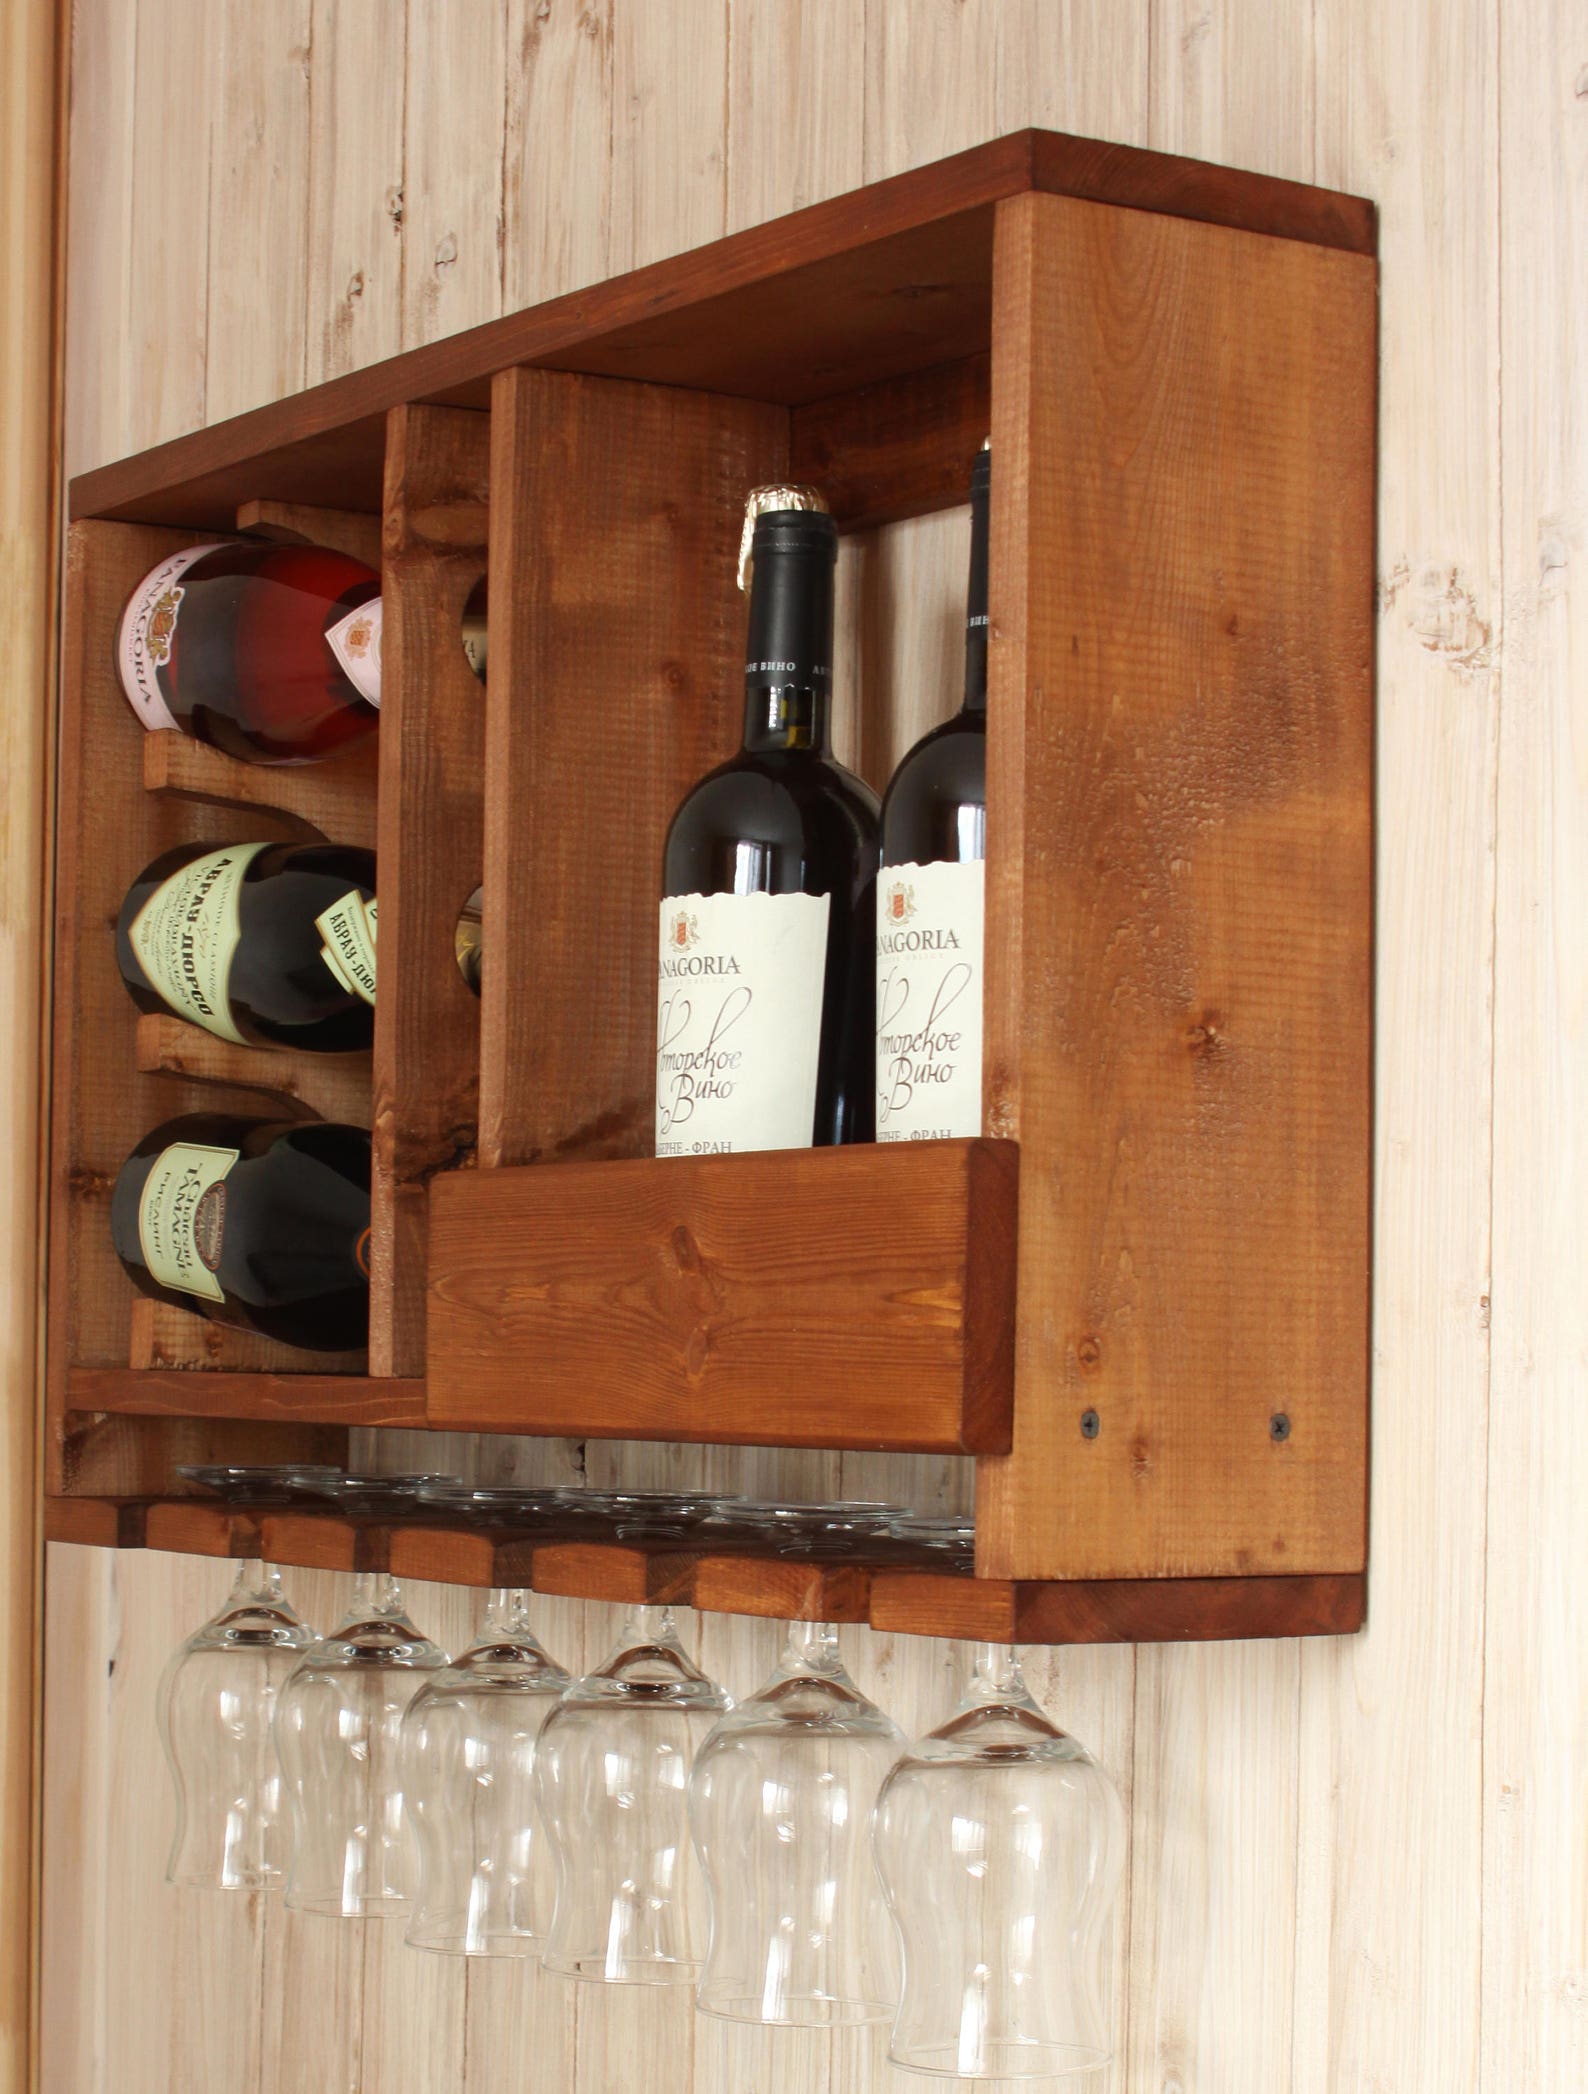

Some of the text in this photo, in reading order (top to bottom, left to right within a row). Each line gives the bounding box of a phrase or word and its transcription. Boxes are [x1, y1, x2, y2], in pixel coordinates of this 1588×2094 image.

[134, 558, 187, 704] FANAGORIA
[760, 662, 796, 671] ВИНО
[181, 858, 233, 1017] АБРАУ-ДЮРСО
[329, 912, 376, 993] АБРАУ-ДЮ
[670, 1073, 737, 1123] Вино
[888, 1056, 958, 1110] Вино
[692, 1141, 732, 1154] ФРАН
[153, 1171, 171, 1259] РИСЛИНГ
